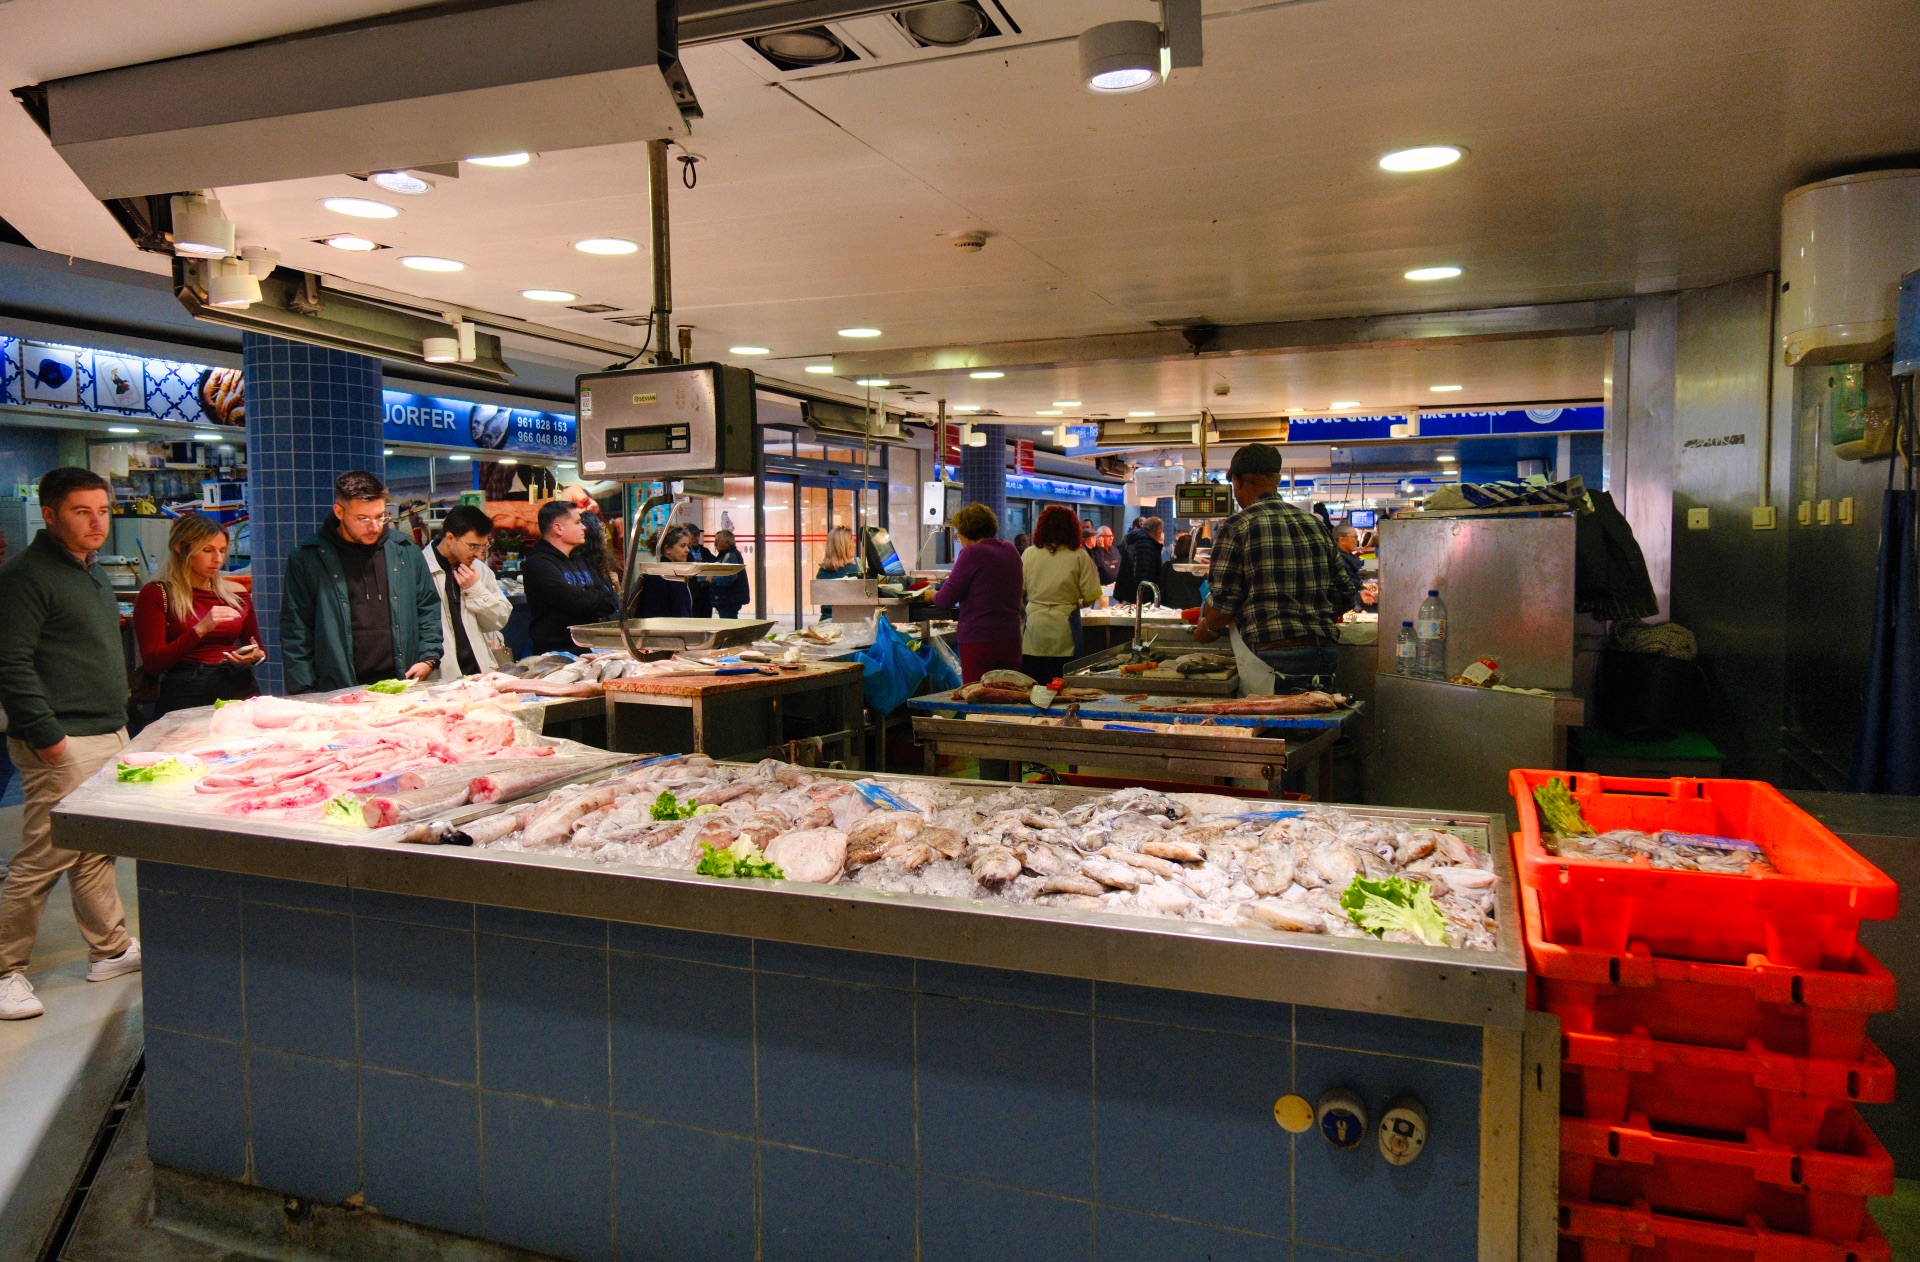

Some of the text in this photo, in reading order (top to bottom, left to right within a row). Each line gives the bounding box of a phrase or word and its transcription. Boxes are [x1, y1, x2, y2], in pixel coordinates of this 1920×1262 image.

[383, 403, 456, 430] JORFER
[517, 416, 568, 432] 961 828 153
[517, 431, 568, 446] 966 048 889
